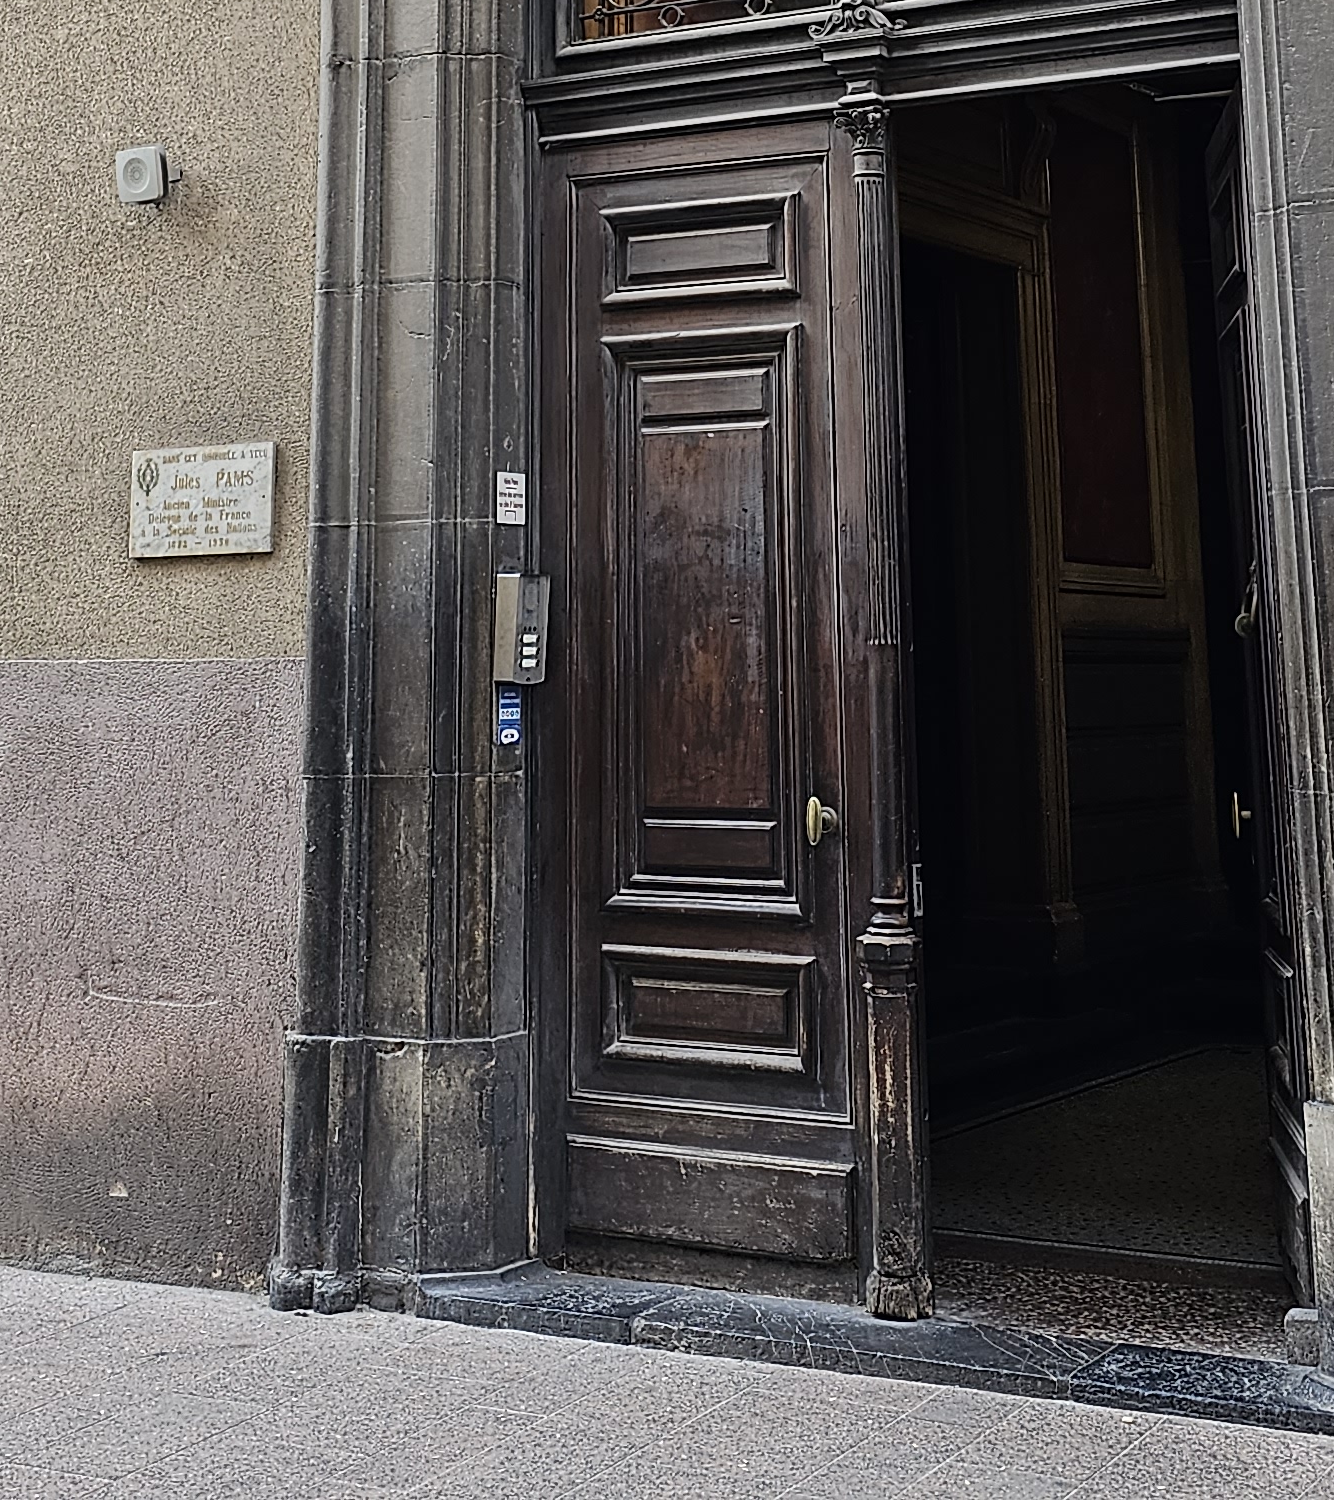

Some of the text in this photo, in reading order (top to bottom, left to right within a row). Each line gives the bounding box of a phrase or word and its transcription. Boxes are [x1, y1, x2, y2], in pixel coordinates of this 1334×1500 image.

[216, 469, 254, 488] PAMS
[162, 497, 239, 511] Ancien Ministre
[188, 511, 198, 522] de
[205, 510, 212, 521] la
[219, 509, 251, 521] France
[153, 525, 160, 536] la
[204, 523, 219, 534] des
[226, 522, 258, 534] Nations
